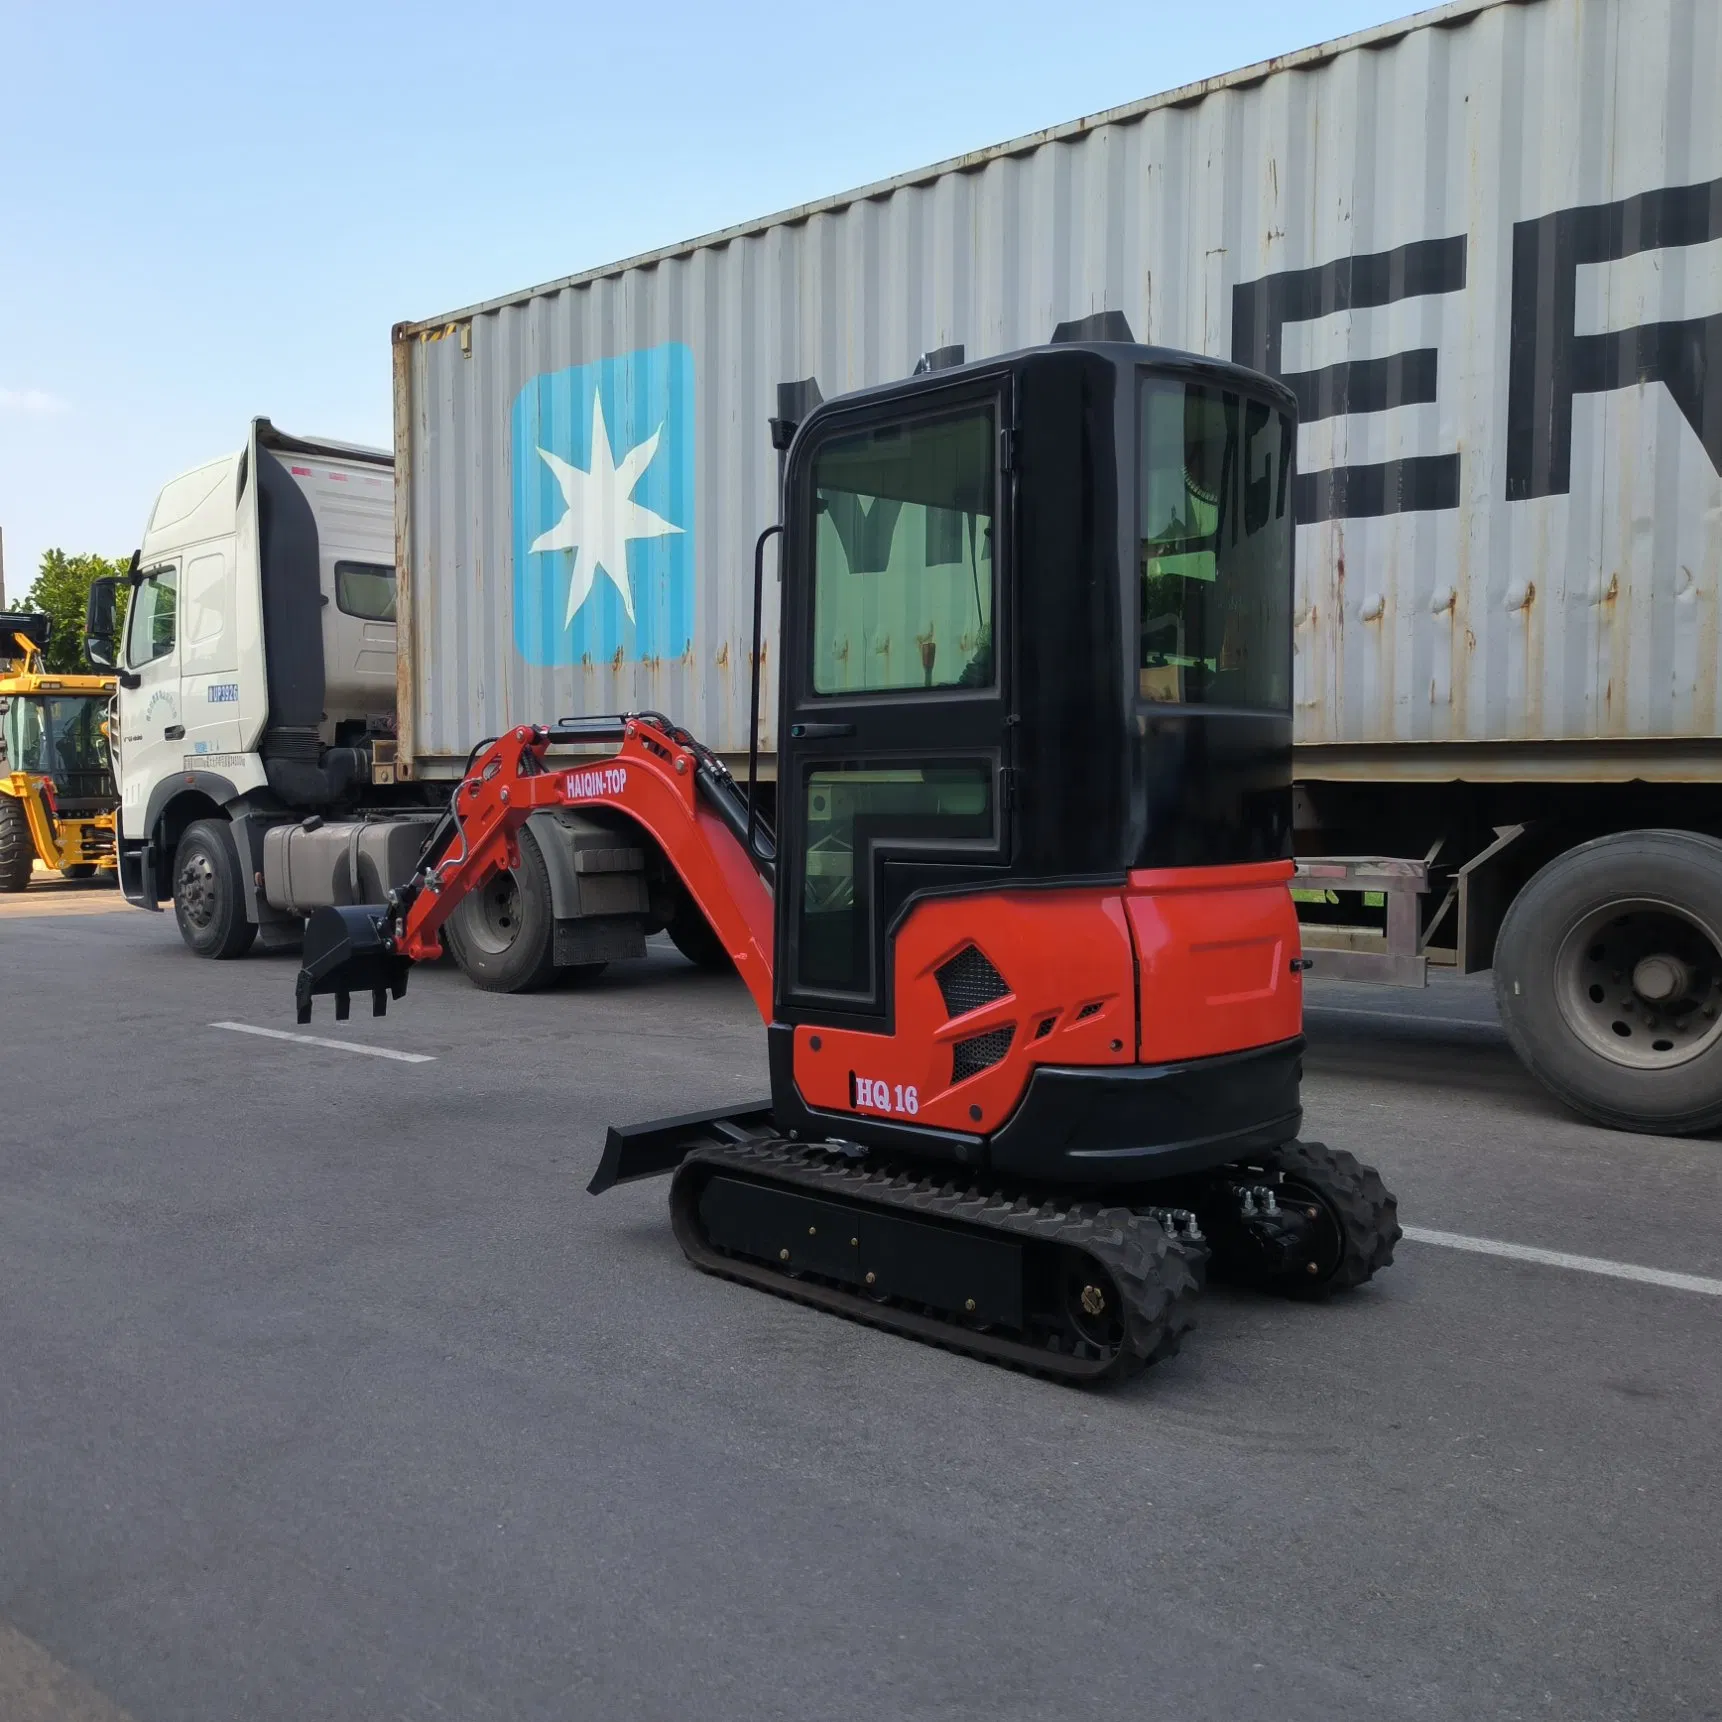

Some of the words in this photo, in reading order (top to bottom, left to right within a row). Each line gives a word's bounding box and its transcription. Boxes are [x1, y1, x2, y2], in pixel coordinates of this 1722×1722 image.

[566, 768, 627, 798] HAIQIN-TOP
[856, 1077, 892, 1113] HQ
[894, 1084, 919, 1115] 16
